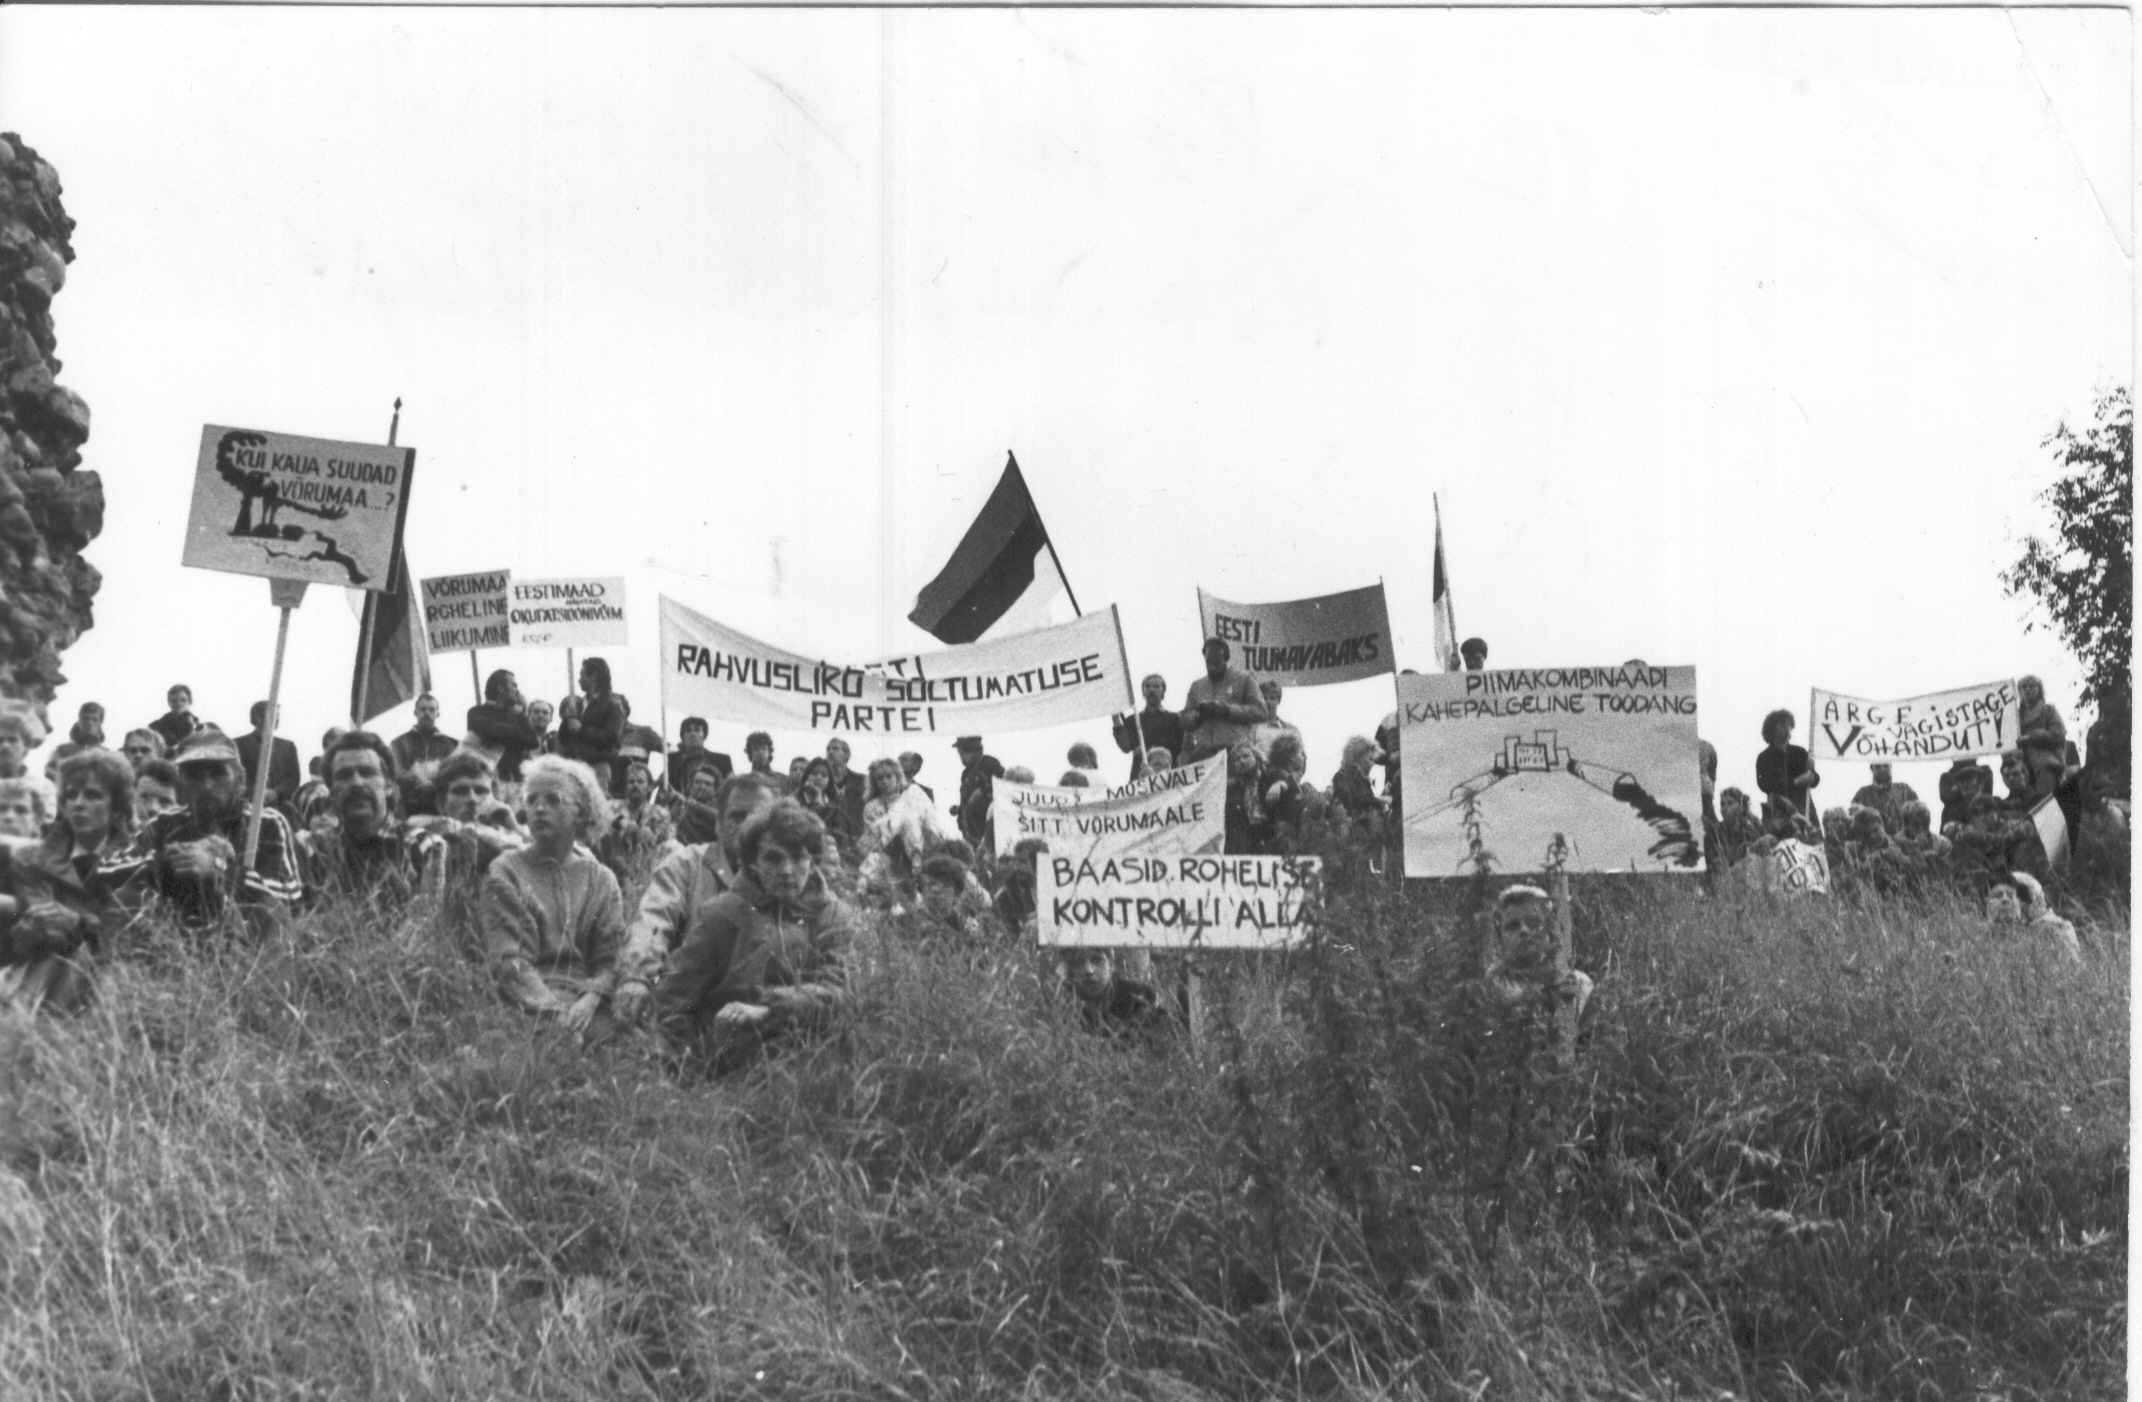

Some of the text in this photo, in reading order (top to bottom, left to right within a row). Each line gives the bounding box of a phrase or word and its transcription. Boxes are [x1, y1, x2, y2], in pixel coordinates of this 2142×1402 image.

[235, 448, 397, 486] KUI KAUA SUUDAD
[514, 583, 605, 601] EESTIMAAD
[1216, 613, 1260, 644] EESTI
[1242, 633, 1379, 672] TUUMAVABAKS
[1466, 667, 1667, 696] PIIMAKOMBINAADI
[811, 701, 935, 732] PARTEI
[1405, 693, 1698, 724] KAHEPALGELINE TOODANG
[1018, 815, 1062, 834] SITT
[1053, 897, 1220, 929] KONTROLLI
